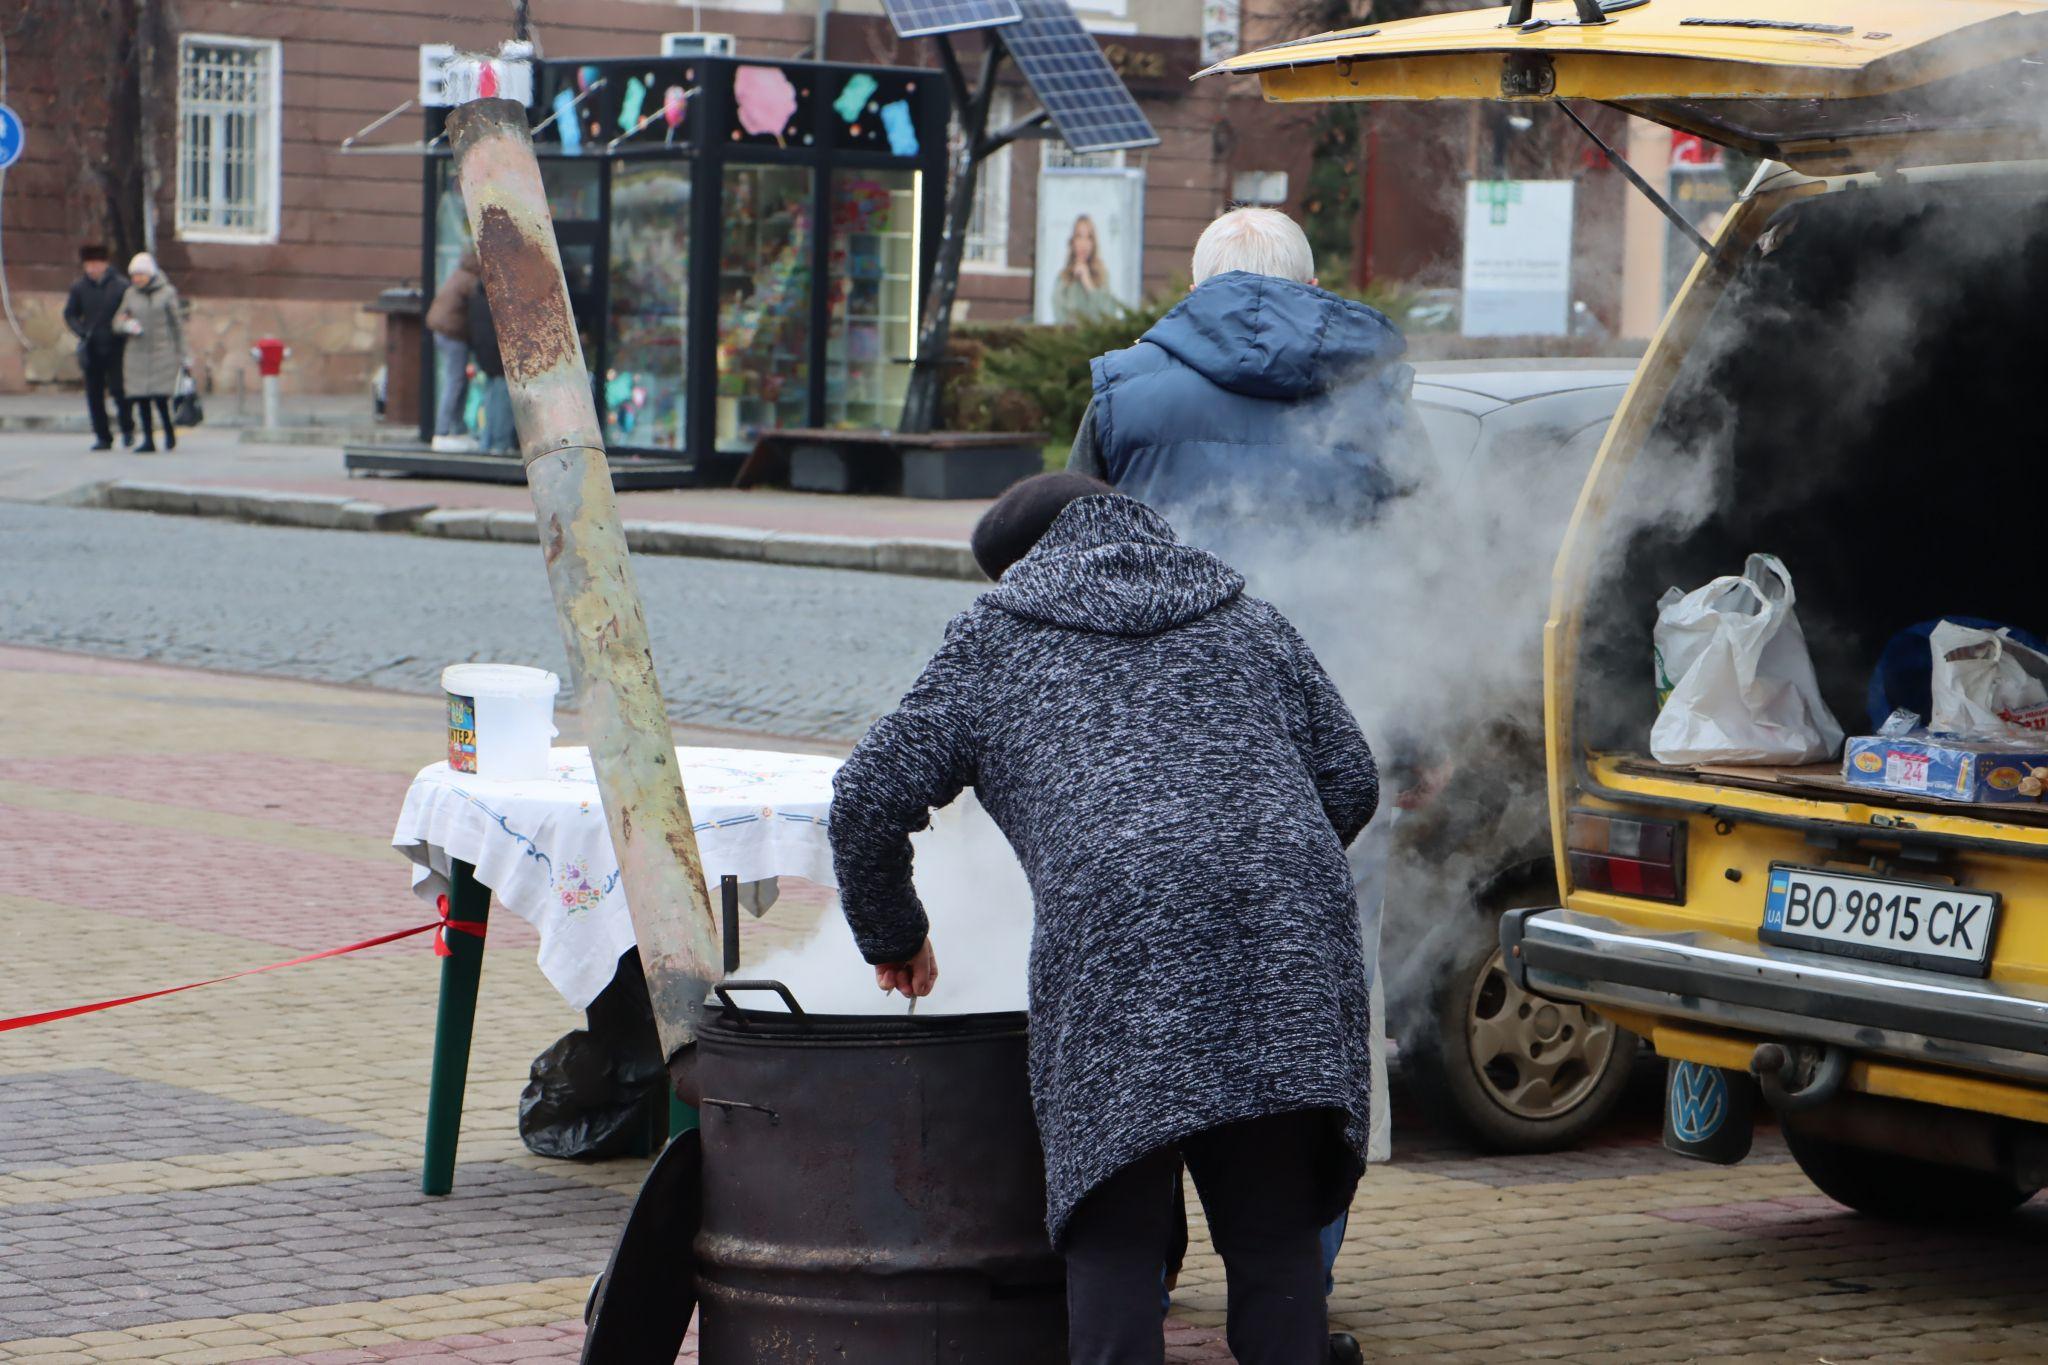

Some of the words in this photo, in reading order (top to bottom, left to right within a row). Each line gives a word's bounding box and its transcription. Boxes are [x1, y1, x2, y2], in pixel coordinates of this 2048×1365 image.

[1903, 761, 1922, 782] 24
[1767, 909, 1781, 925] UA
[1786, 882, 1836, 930] BO
[1843, 890, 1921, 941] 9815
[1928, 901, 1981, 950] CK
